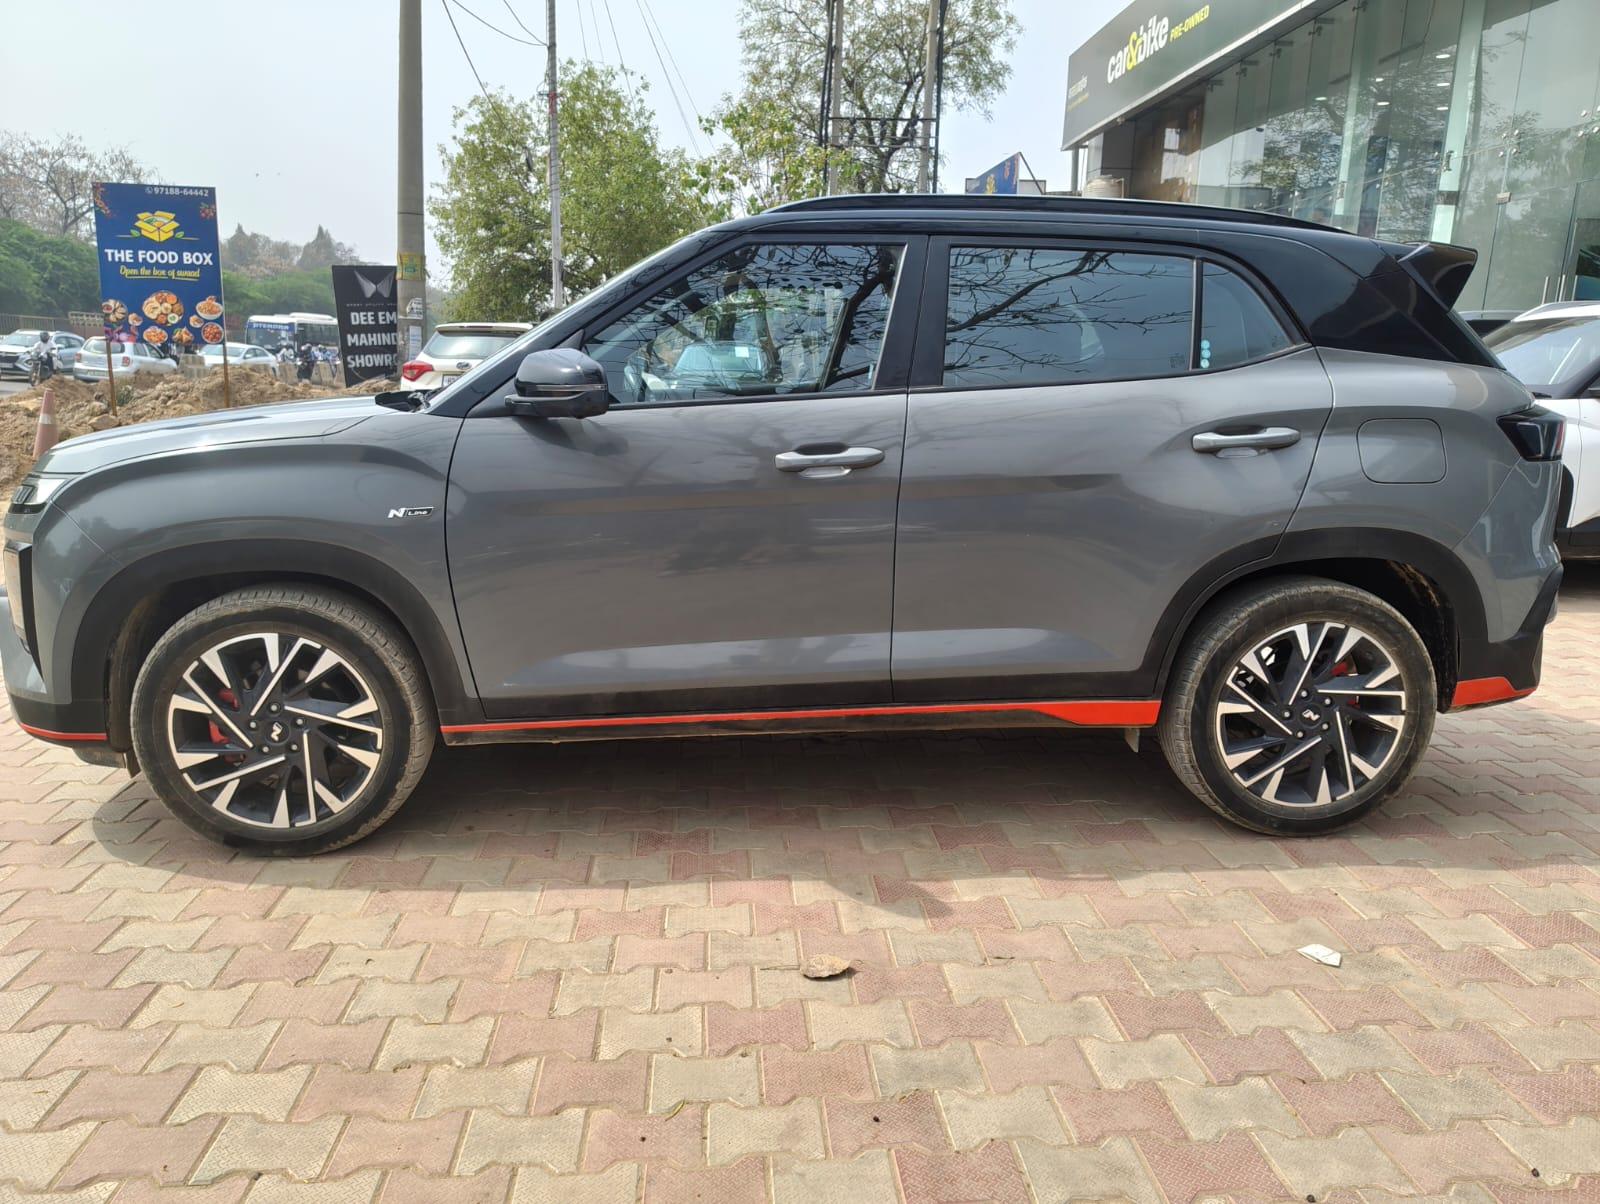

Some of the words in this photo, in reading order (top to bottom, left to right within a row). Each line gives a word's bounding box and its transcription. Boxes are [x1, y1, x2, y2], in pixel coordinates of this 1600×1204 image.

[1170, 4, 1210, 43] PRE-OWNED
[105, 249, 134, 263] THE
[138, 250, 179, 264] FOOD
[183, 252, 214, 266] BOX
[350, 311, 375, 325] DEE
